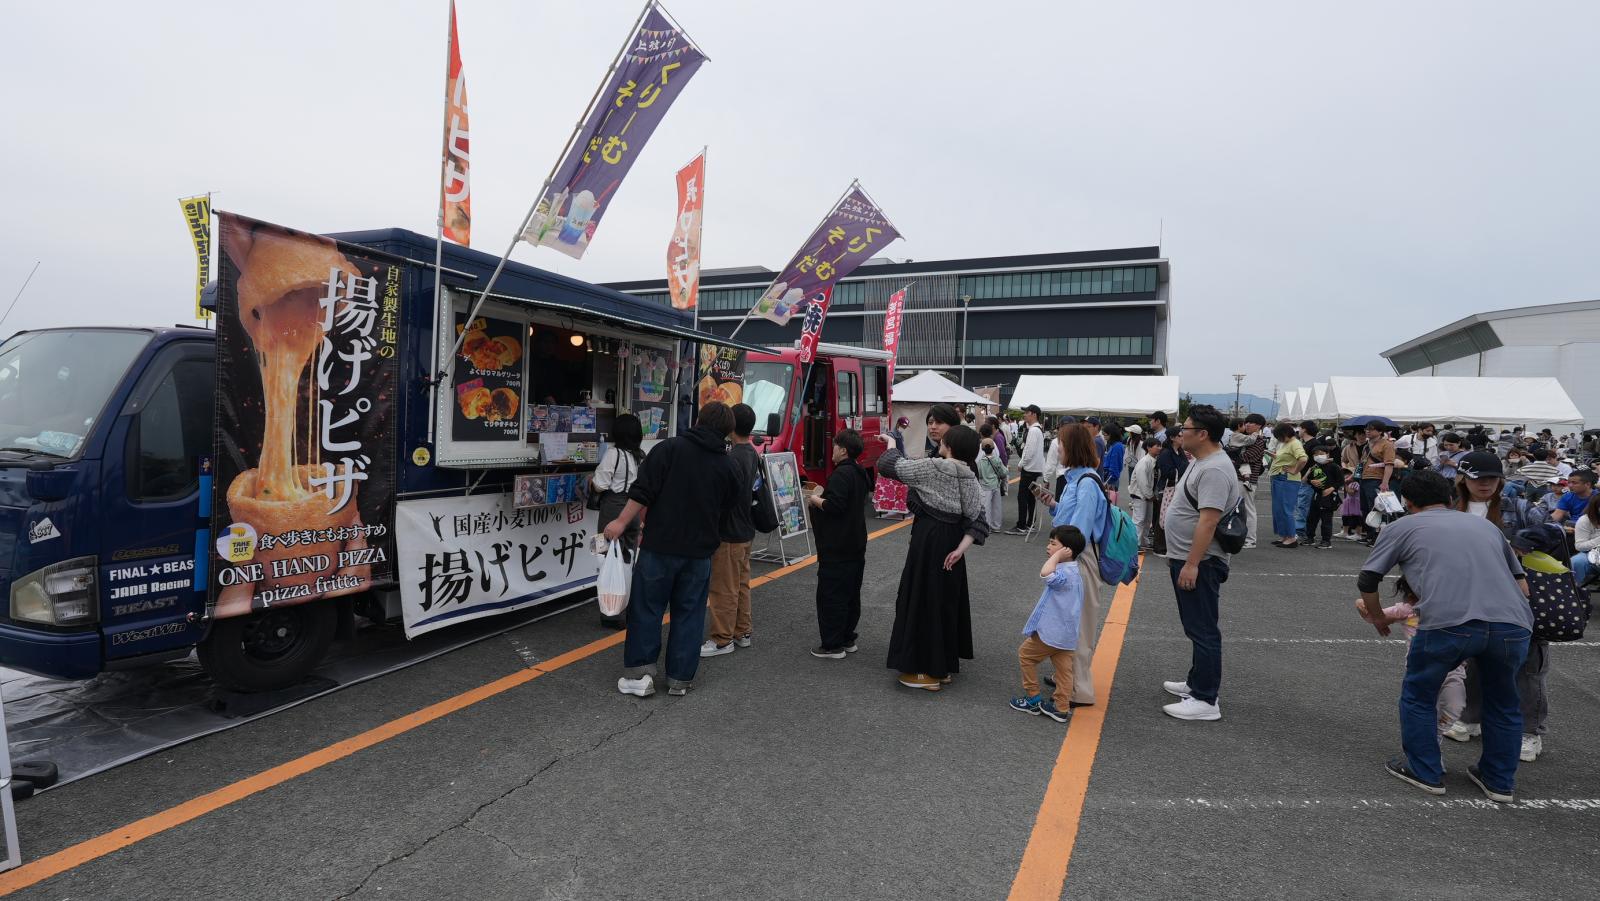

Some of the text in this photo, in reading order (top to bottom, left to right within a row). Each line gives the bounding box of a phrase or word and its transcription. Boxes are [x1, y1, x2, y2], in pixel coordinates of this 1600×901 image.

[601, 61, 681, 165] くりーむ
[795, 226, 846, 274] そーだ
[815, 227, 882, 281] くりーむ
[380, 264, 400, 359] 自家製生地の
[308, 266, 379, 515] 揚げピザ
[259, 523, 387, 551] 食べ歩きにもおすすめ
[453, 506, 562, 538] 国産小麦100%
[218, 547, 387, 586] ONE HAND PIZZA
[233, 546, 249, 554] OUT
[109, 559, 196, 581] FINAL BEAS
[151, 578, 191, 593] Racing
[418, 529, 587, 612] 揚げピザ
[112, 595, 179, 616] BEAST
